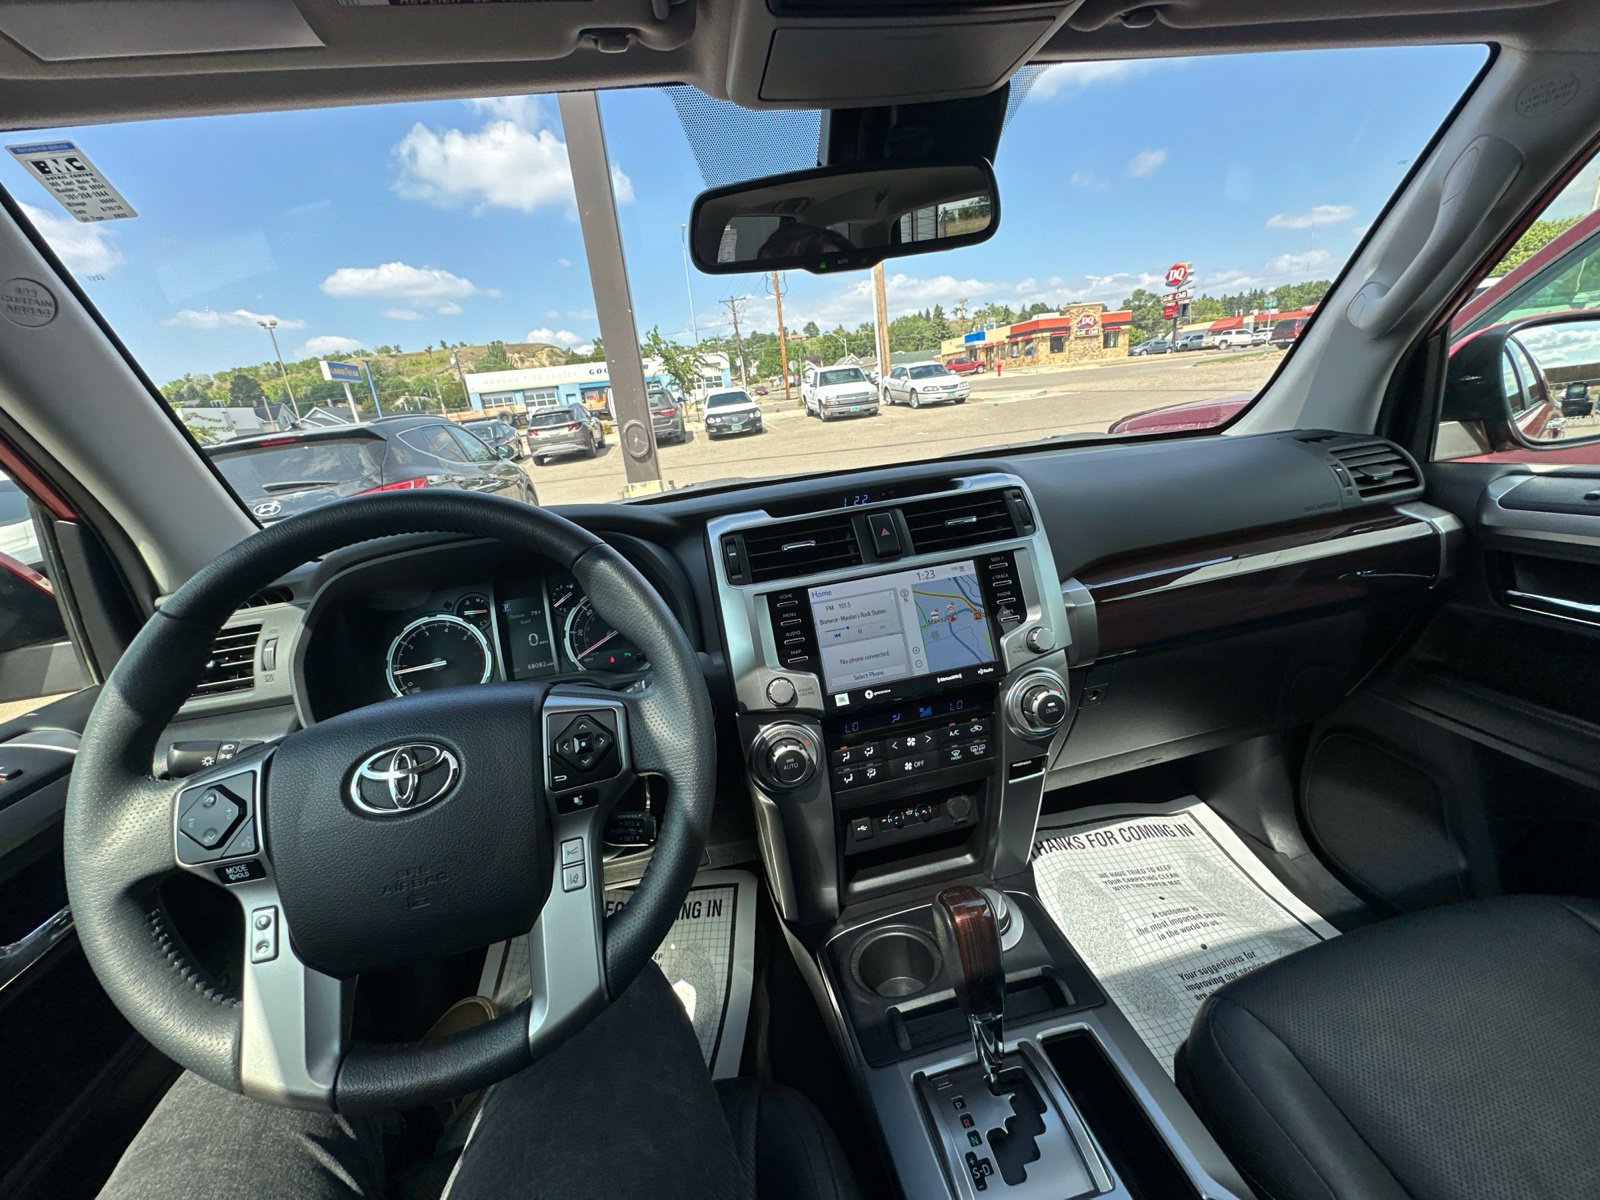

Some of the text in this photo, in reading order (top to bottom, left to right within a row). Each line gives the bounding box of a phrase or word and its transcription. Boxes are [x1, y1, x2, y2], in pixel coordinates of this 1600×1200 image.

[1168, 267, 1184, 281] DQ
[916, 569, 936, 581] 1:23
[811, 590, 833, 599] Home
[528, 633, 539, 646] 0
[849, 654, 864, 663] phone
[783, 762, 799, 770] AUTO
[914, 760, 925, 768] OFF
[1085, 830, 1119, 848] FOR
[1118, 823, 1175, 843] COMING
[1173, 822, 1195, 837] IN
[225, 864, 248, 875] MODE
[706, 899, 723, 917] IN
[1158, 907, 1191, 917] customer
[1136, 927, 1150, 936] the
[1150, 920, 1169, 932] most
[1168, 913, 1204, 926] important
[1156, 933, 1167, 941] in
[1165, 929, 1180, 938] the
[1179, 922, 1201, 934] world
[1178, 951, 1256, 981] Your suggestions for
[1184, 975, 1226, 991] improving
[1224, 971, 1239, 980] our
[955, 1101, 962, 1110] P
[963, 1119, 971, 1128] R
[970, 1136, 980, 1146] N
